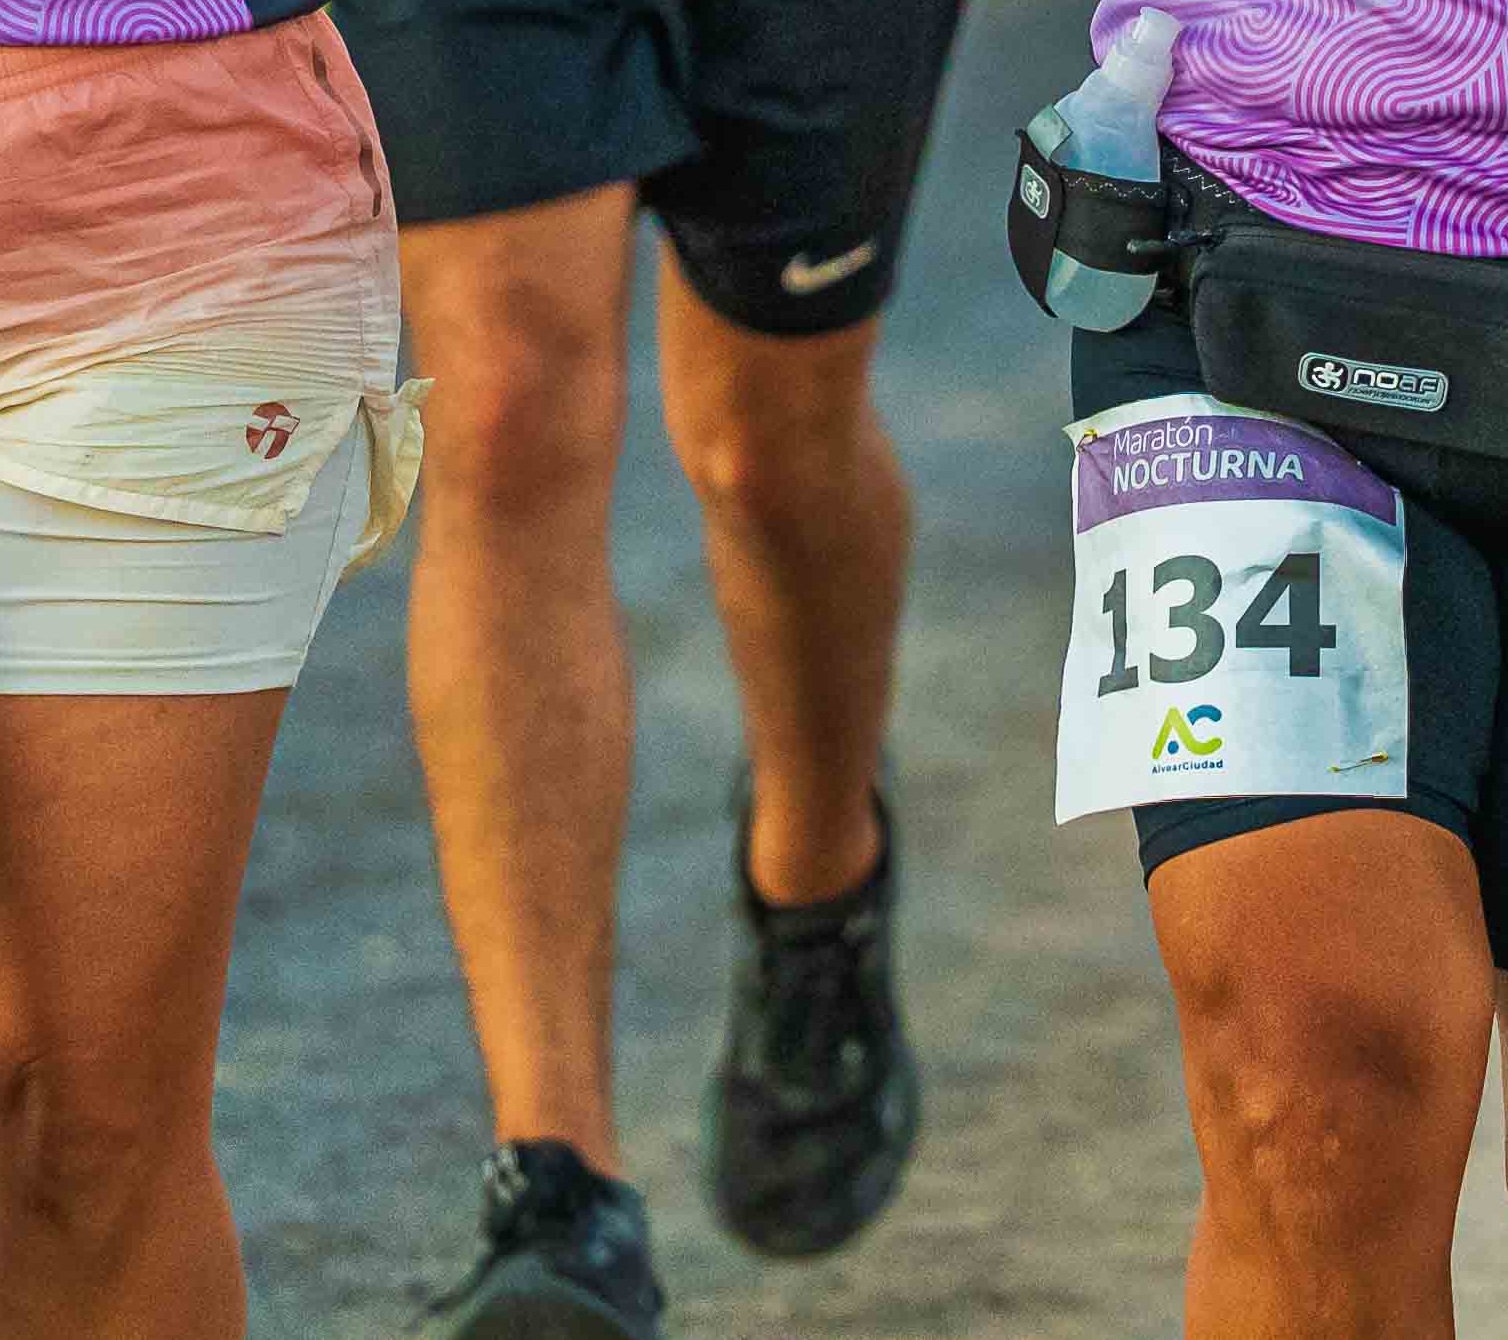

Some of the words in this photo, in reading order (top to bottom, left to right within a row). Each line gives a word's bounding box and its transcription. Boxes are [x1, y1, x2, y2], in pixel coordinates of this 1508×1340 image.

[1113, 416, 1214, 460] Maratón
[1112, 449, 1305, 496] NOCTURNA
[1097, 552, 1338, 698] 134
[1151, 759, 1224, 774] AlvearCiudad
